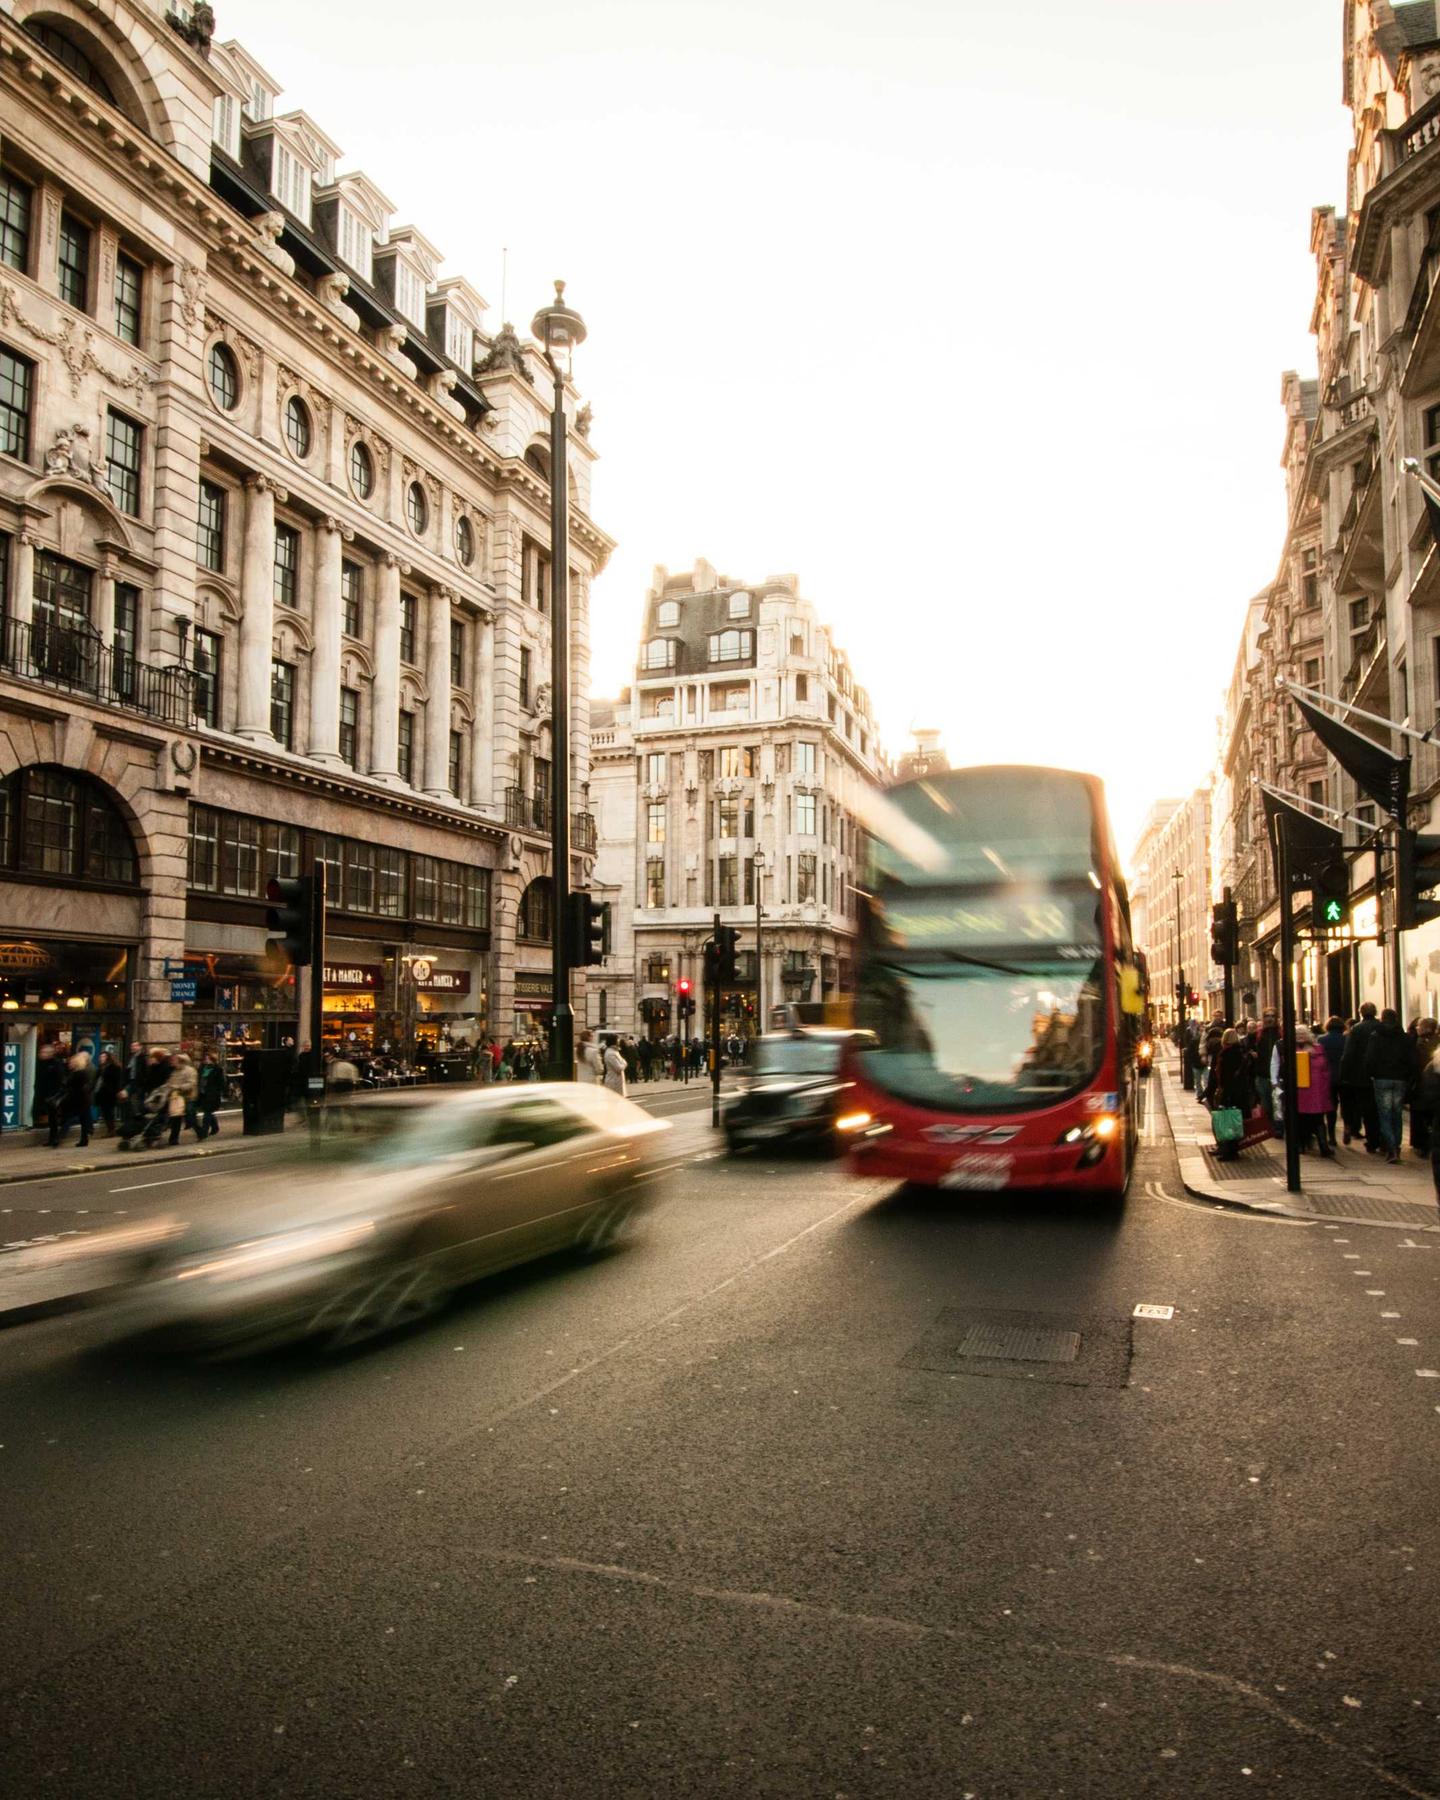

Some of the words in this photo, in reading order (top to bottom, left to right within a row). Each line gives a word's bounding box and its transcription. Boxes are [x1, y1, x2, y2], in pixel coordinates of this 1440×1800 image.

[332, 969, 337, 982] A
[338, 969, 363, 983] MANGER
[433, 975, 453, 987] MANGER
[4, 1045, 17, 1123] MONEY
